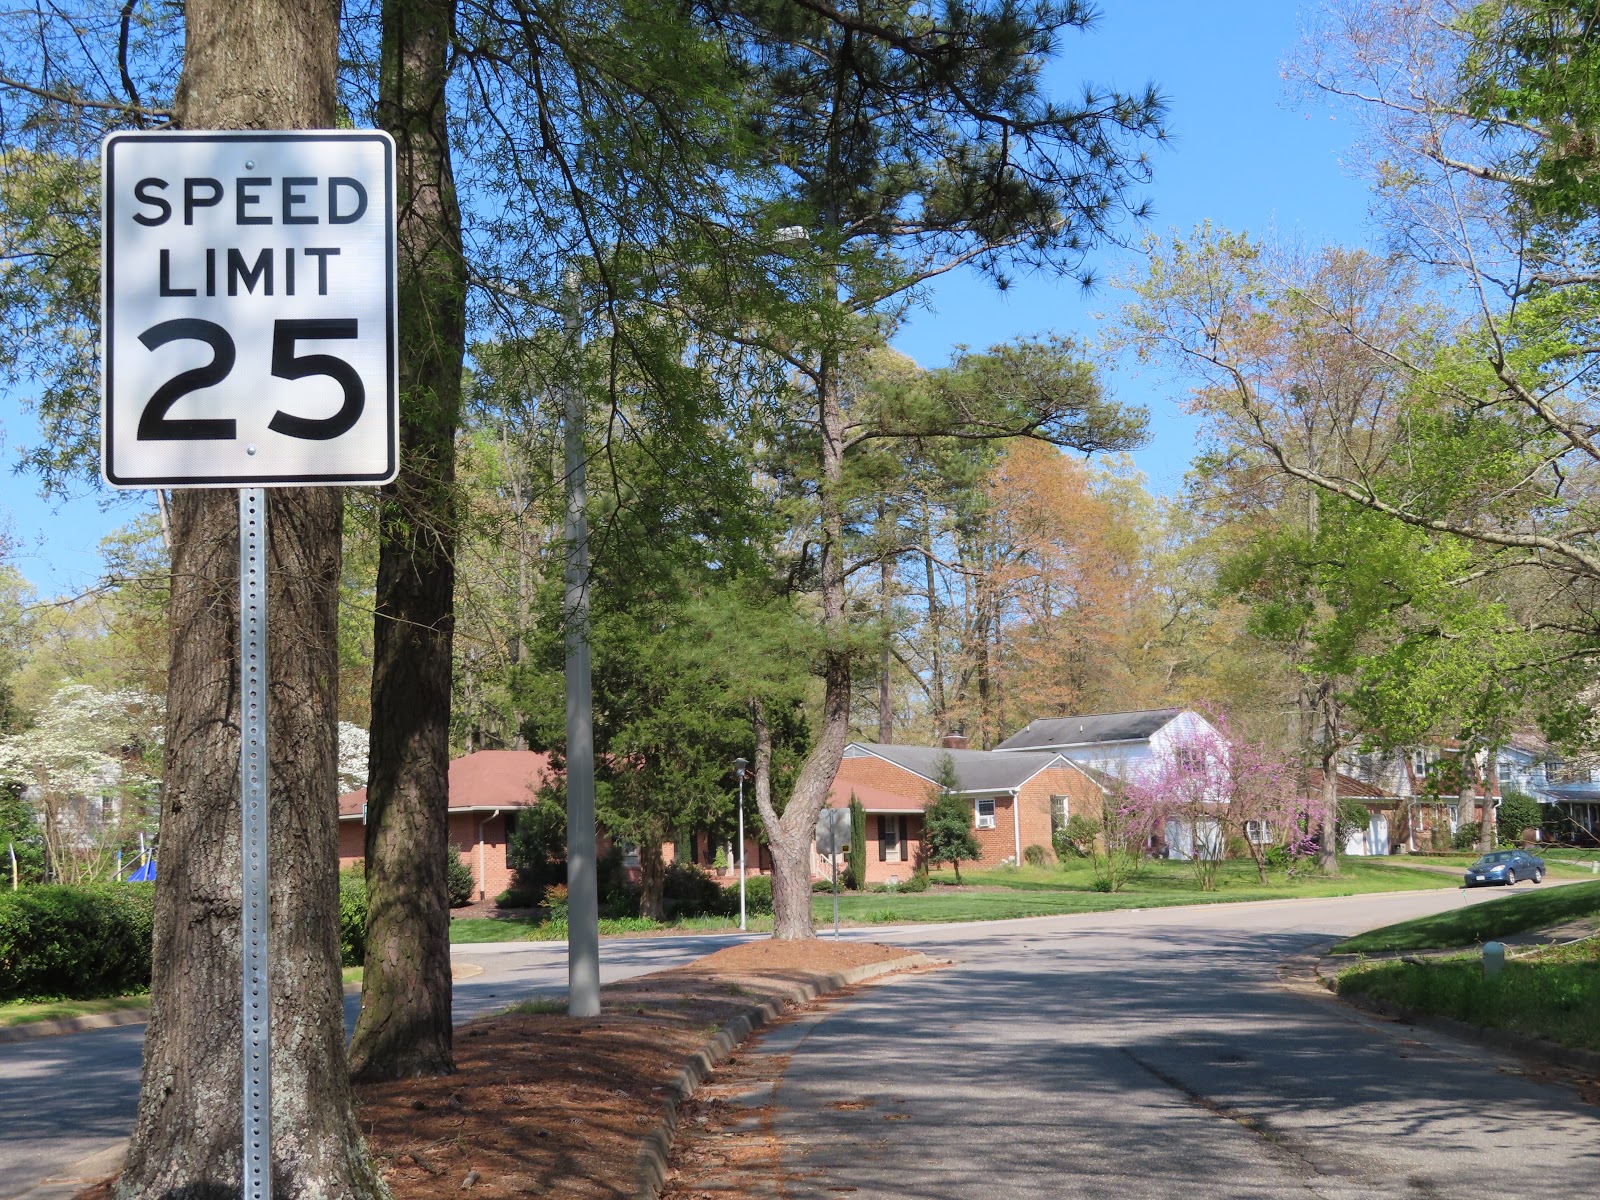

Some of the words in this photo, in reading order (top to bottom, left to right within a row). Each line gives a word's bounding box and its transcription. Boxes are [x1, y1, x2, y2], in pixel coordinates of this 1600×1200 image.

[132, 177, 368, 227] SPEED
[159, 248, 340, 298] LIMIT
[136, 318, 366, 441] 25
